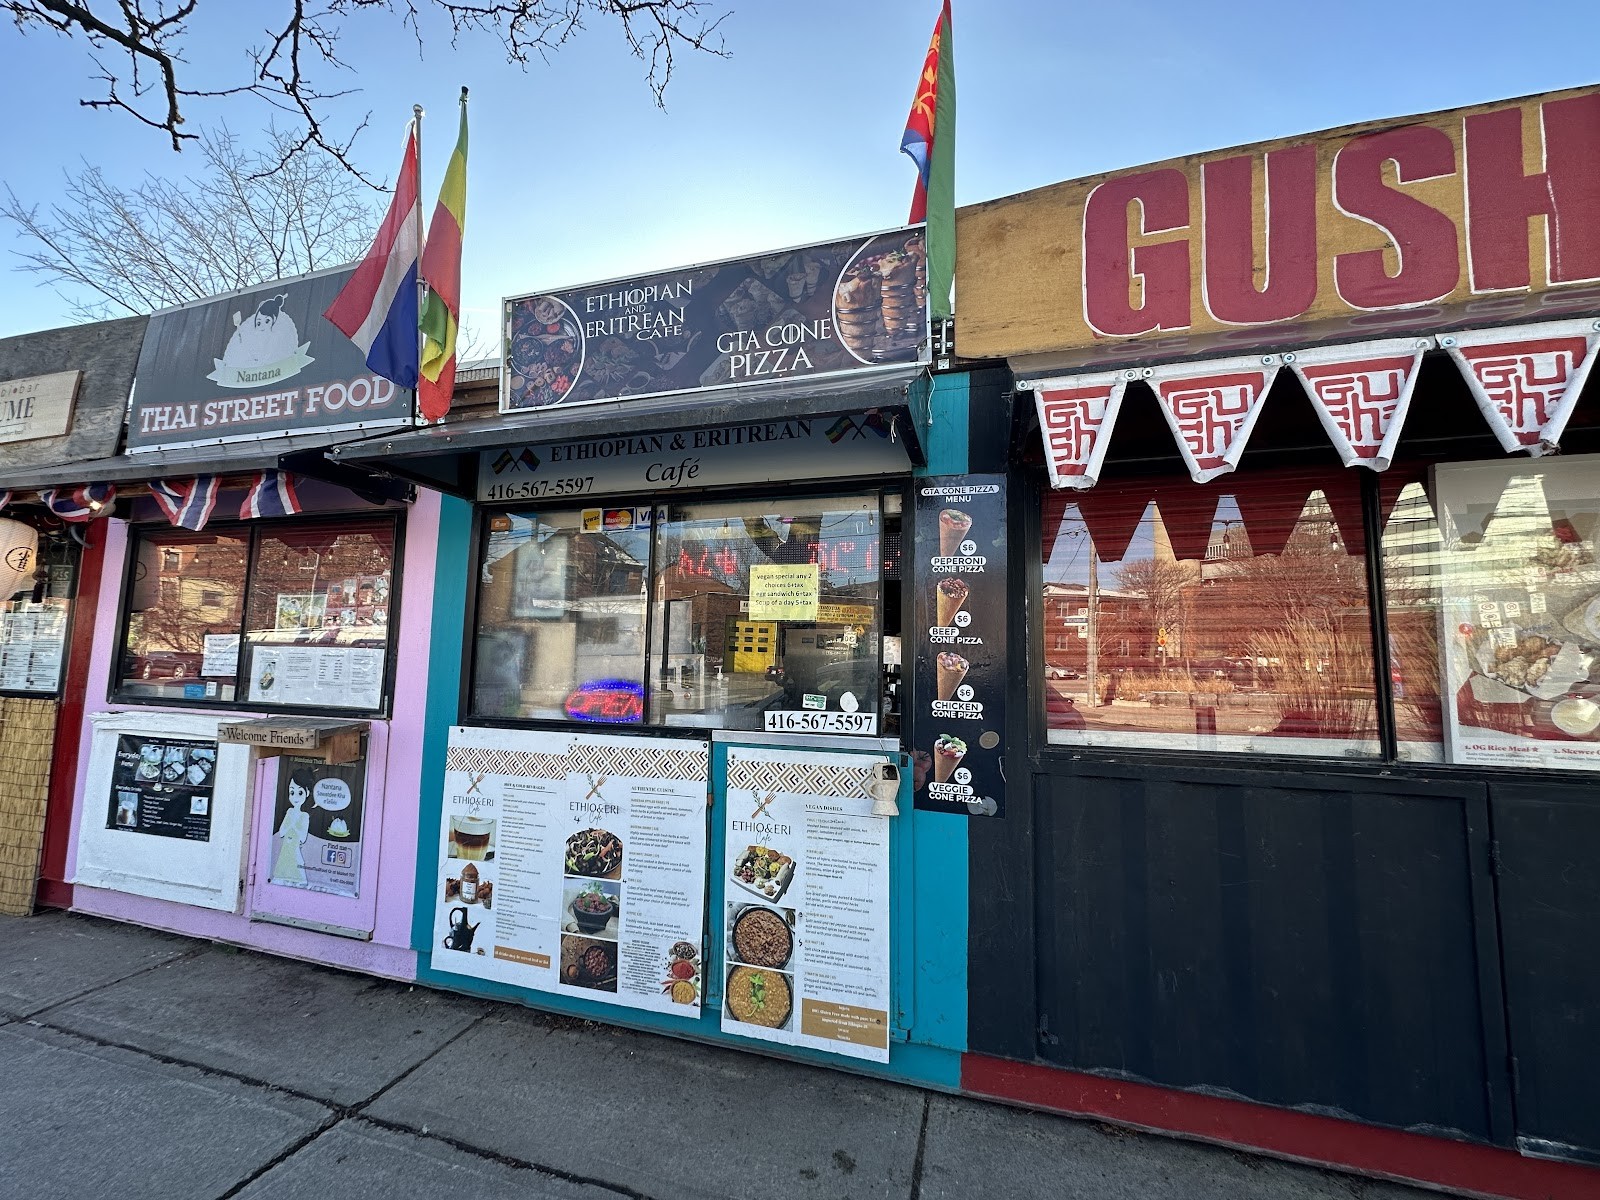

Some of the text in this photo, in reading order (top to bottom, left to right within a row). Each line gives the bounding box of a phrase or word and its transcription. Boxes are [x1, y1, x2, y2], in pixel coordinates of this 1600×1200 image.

[586, 280, 692, 313] ETHIOPIAN
[625, 304, 646, 314] AND
[586, 307, 684, 338] ERITREAN
[636, 324, 682, 341] CAFE
[716, 318, 832, 354] GTA CONE
[730, 346, 814, 378] PIZZA
[237, 368, 281, 382] Nantana
[141, 376, 394, 432] THAI STREET FOOD
[550, 420, 812, 462] ETHIOPIAN & ERITREAN
[645, 457, 700, 488] Café
[488, 476, 594, 500] 416-567-5597
[565, 692, 643, 716] OPEN
[935, 702, 979, 711] CHICKEN
[768, 713, 873, 732] 416-567-5597
[932, 710, 984, 720] CONE PIZZA
[226, 728, 304, 744] Welcome Friends
[929, 792, 983, 805] CONE PIZZA
[932, 784, 968, 794] VEGGIE
[732, 820, 791, 835] ETHIO&ERI
